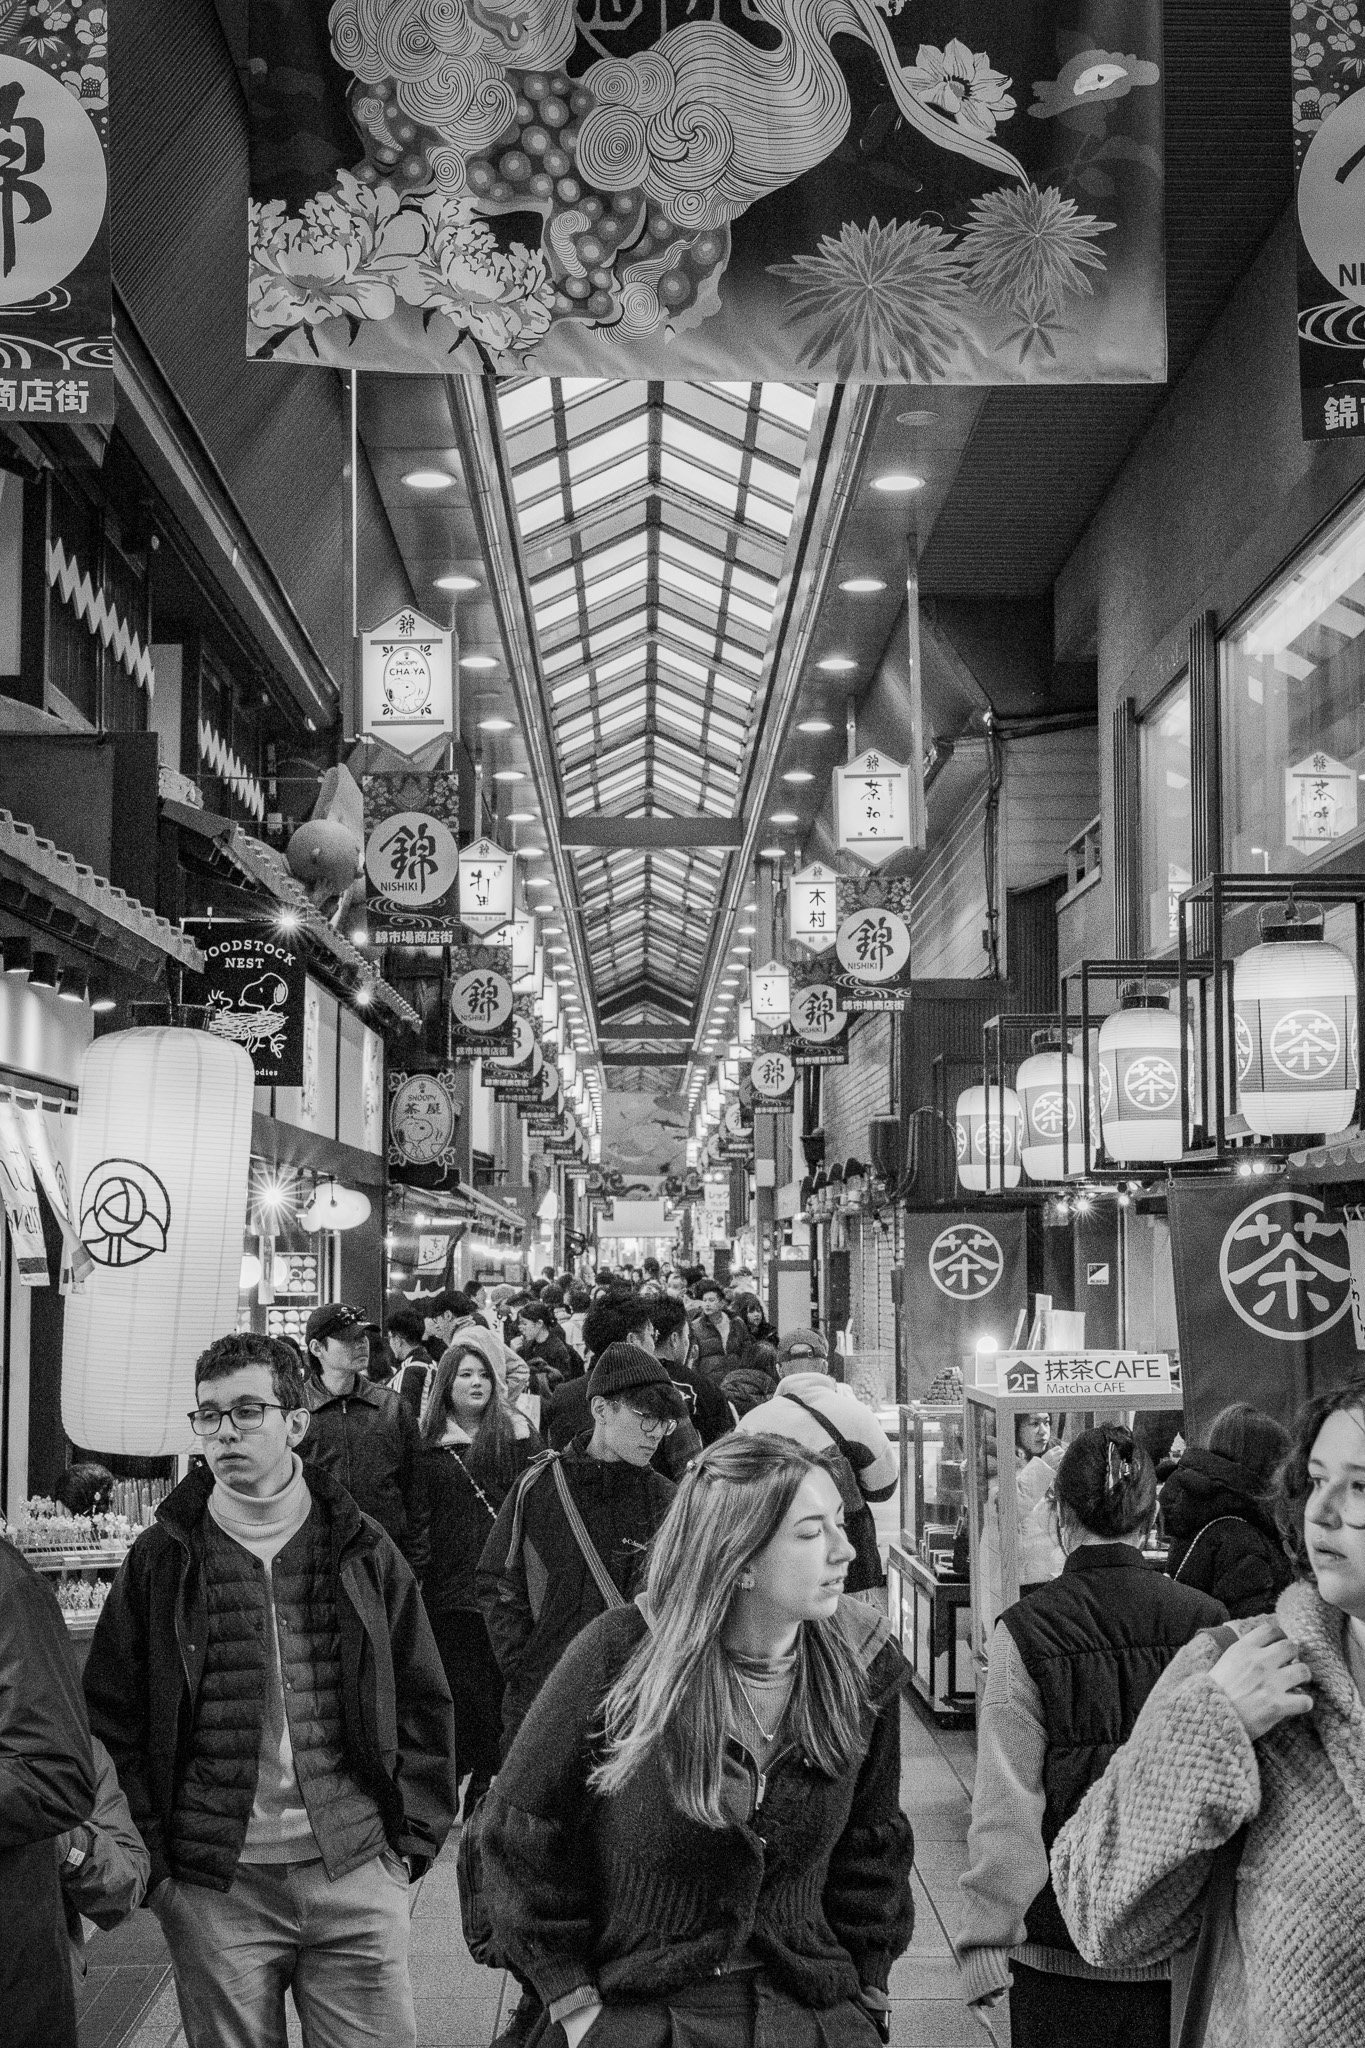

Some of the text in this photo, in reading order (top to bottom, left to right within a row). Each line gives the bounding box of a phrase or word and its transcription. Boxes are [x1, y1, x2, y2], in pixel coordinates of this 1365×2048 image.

[1324, 395, 1365, 431] 錦
[379, 822, 439, 894] 錦
[380, 882, 418, 891] NISHIKI
[809, 888, 826, 928] 木村
[204, 940, 296, 966] OODSTOCK
[375, 930, 453, 944] 錦市場商店街
[847, 916, 894, 972] 錦
[224, 957, 265, 969] NEST
[847, 962, 877, 970] NISHIKI
[460, 976, 499, 1023] 錦
[798, 990, 835, 1034] 錦
[1273, 1018, 1338, 1071] 茶
[255, 1068, 278, 1077] odies
[757, 1058, 785, 1090] 錦
[1126, 1062, 1177, 1104] 茶
[1034, 1098, 1075, 1131] 茶
[932, 1233, 1000, 1290] 茶
[1228, 1211, 1350, 1320] 茶
[1009, 1373, 1036, 1391] 2F
[1044, 1359, 1161, 1381] 抹茶CAFE
[1046, 1382, 1126, 1394] Matcha CAFE
